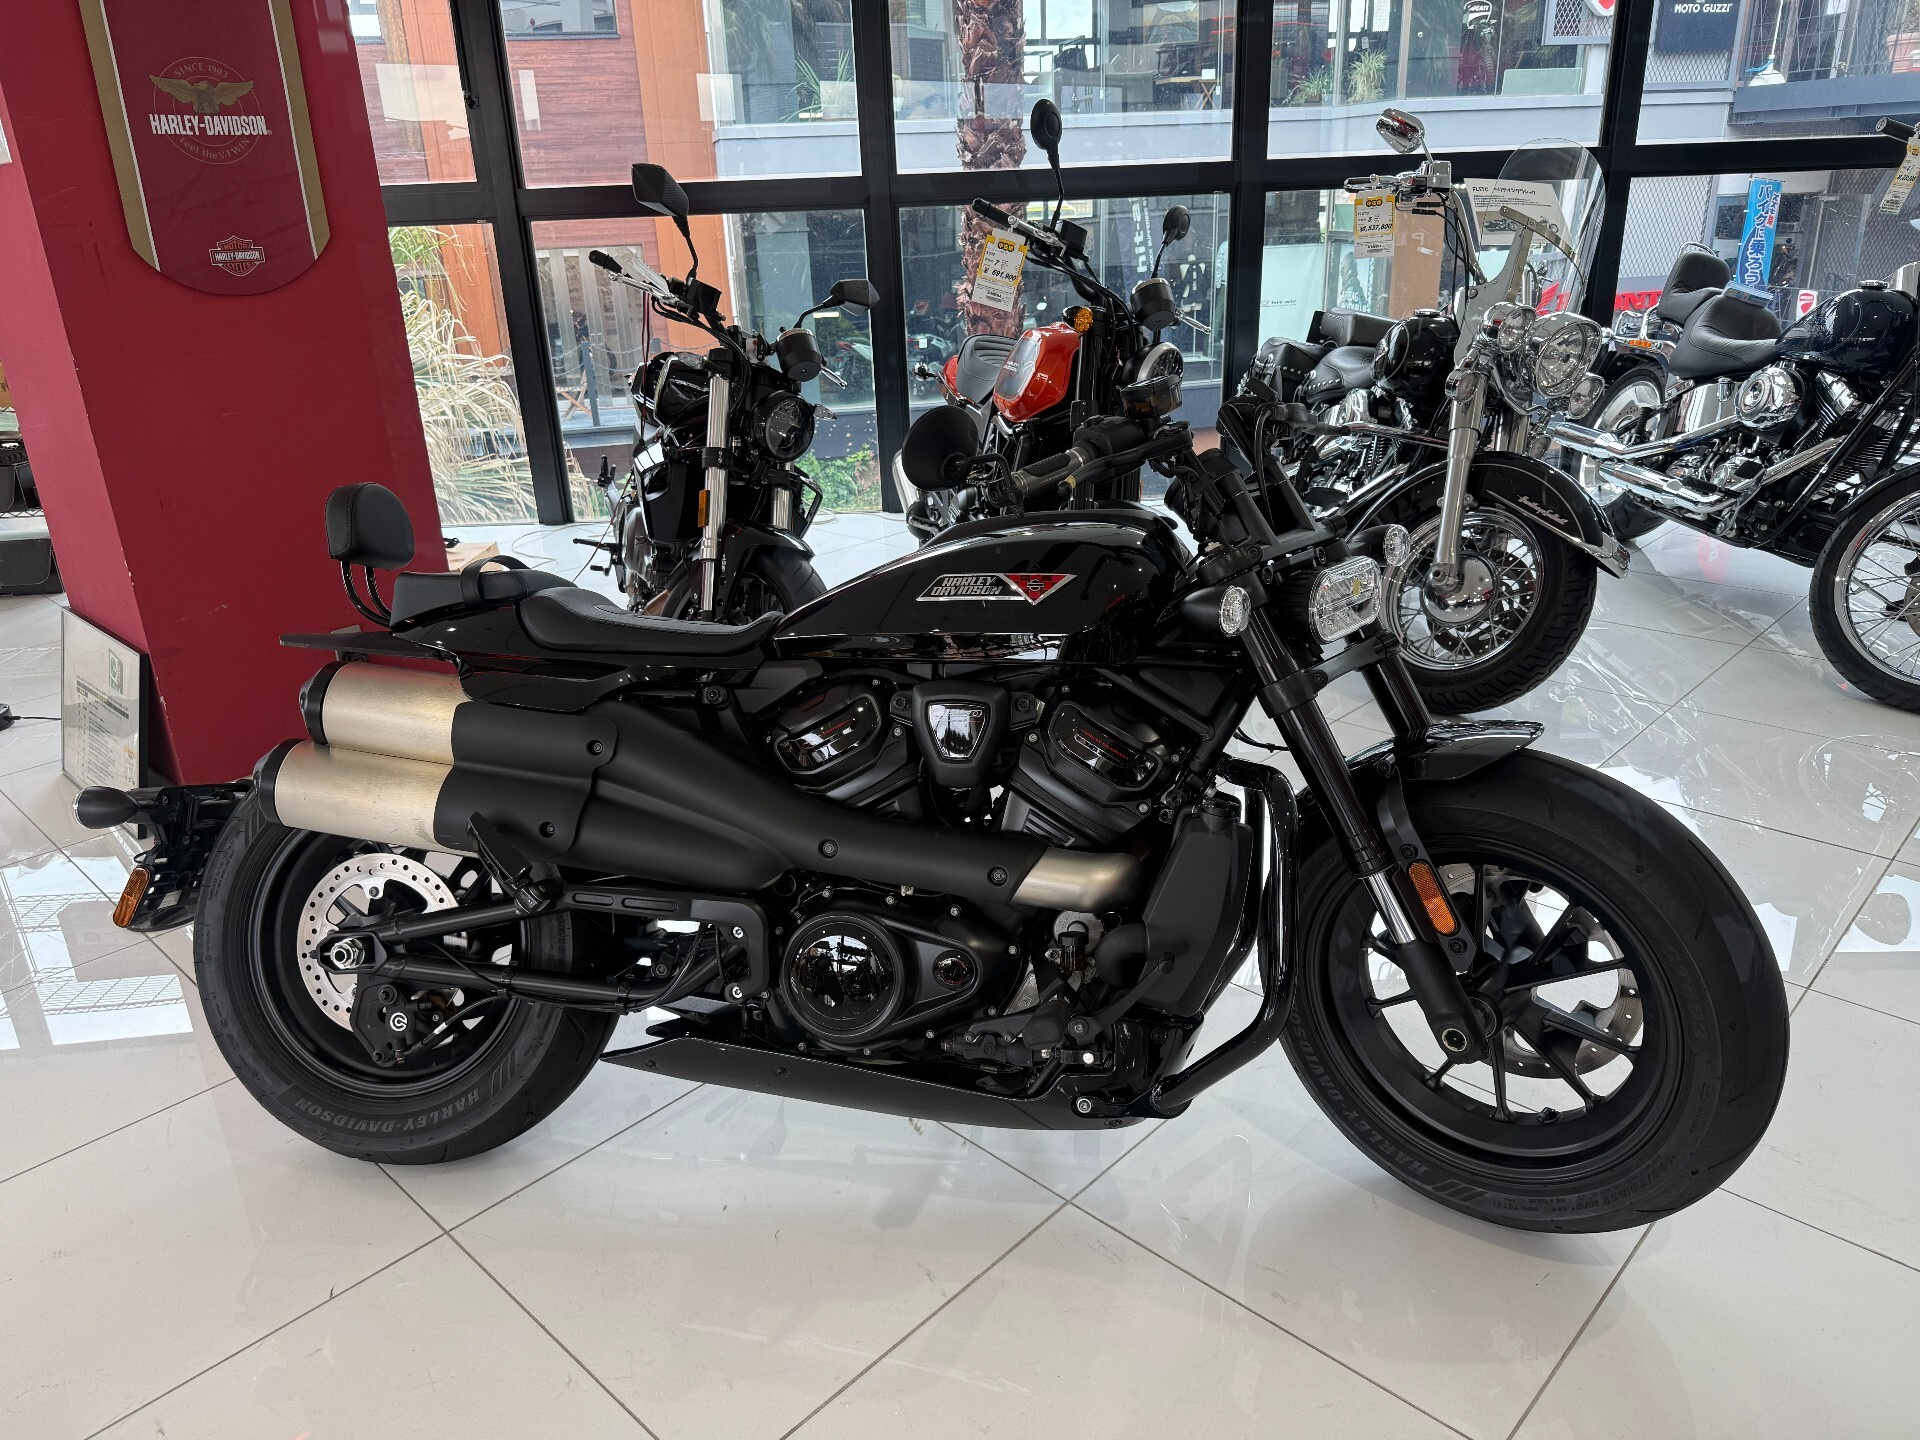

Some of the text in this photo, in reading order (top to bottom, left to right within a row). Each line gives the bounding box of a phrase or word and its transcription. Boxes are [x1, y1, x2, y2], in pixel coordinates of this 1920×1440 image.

[1674, 3, 1730, 13] MOTO GUZZI
[175, 62, 228, 79] SINCE 1903
[149, 113, 267, 136] HARLEY-DAVIDSON
[180, 137, 199, 154] Feel
[202, 149, 218, 159] the
[223, 241, 248, 250] MOTOR
[214, 250, 260, 261] HARLEY-DAVIDSON
[942, 576, 996, 587] HARLEY
[931, 586, 1003, 596] DAVIDSON
[1289, 1006, 1429, 1176] HARLEY-DAVIDSO
[294, 1087, 480, 1133] HARLEY-DAVIDSON
